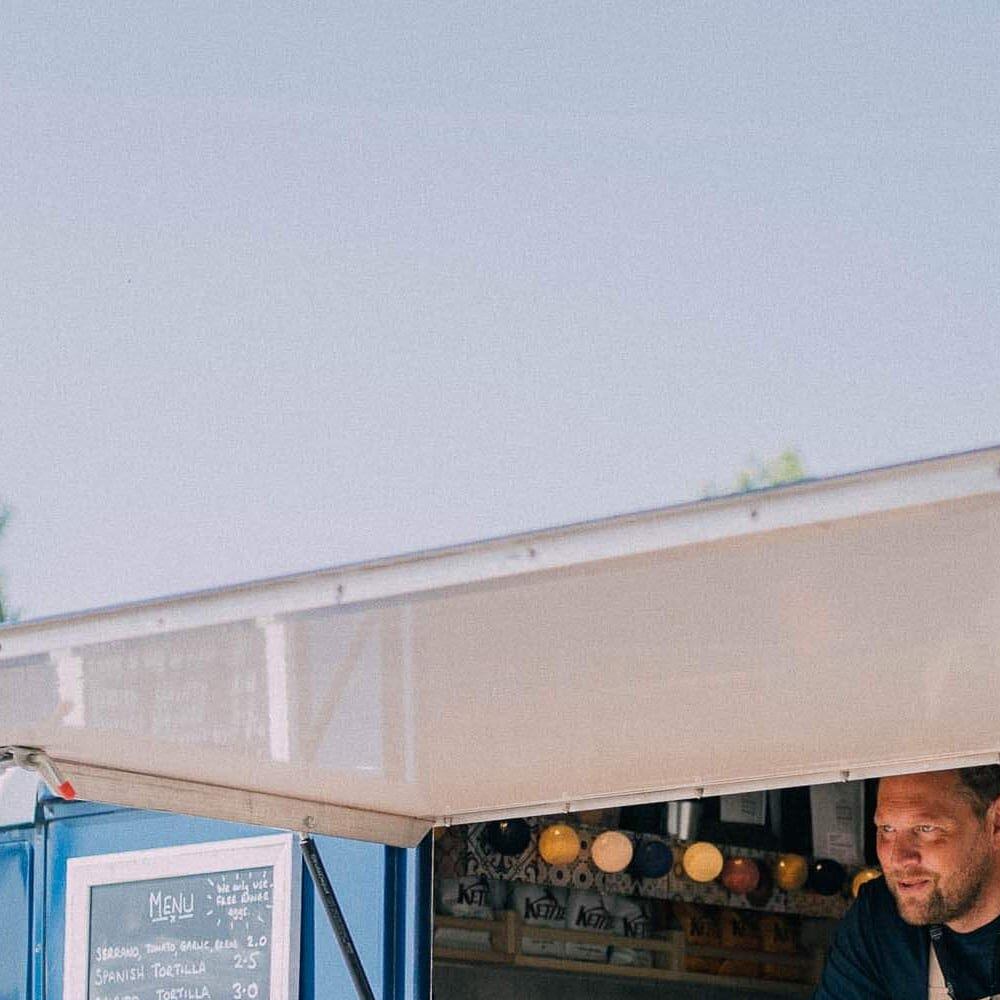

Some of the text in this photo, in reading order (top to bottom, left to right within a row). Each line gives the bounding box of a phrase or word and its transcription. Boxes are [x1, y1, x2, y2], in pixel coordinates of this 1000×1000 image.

[149, 892, 194, 917] MENU
[95, 965, 144, 986] SPANISH
[151, 961, 206, 978] TORTILLA
